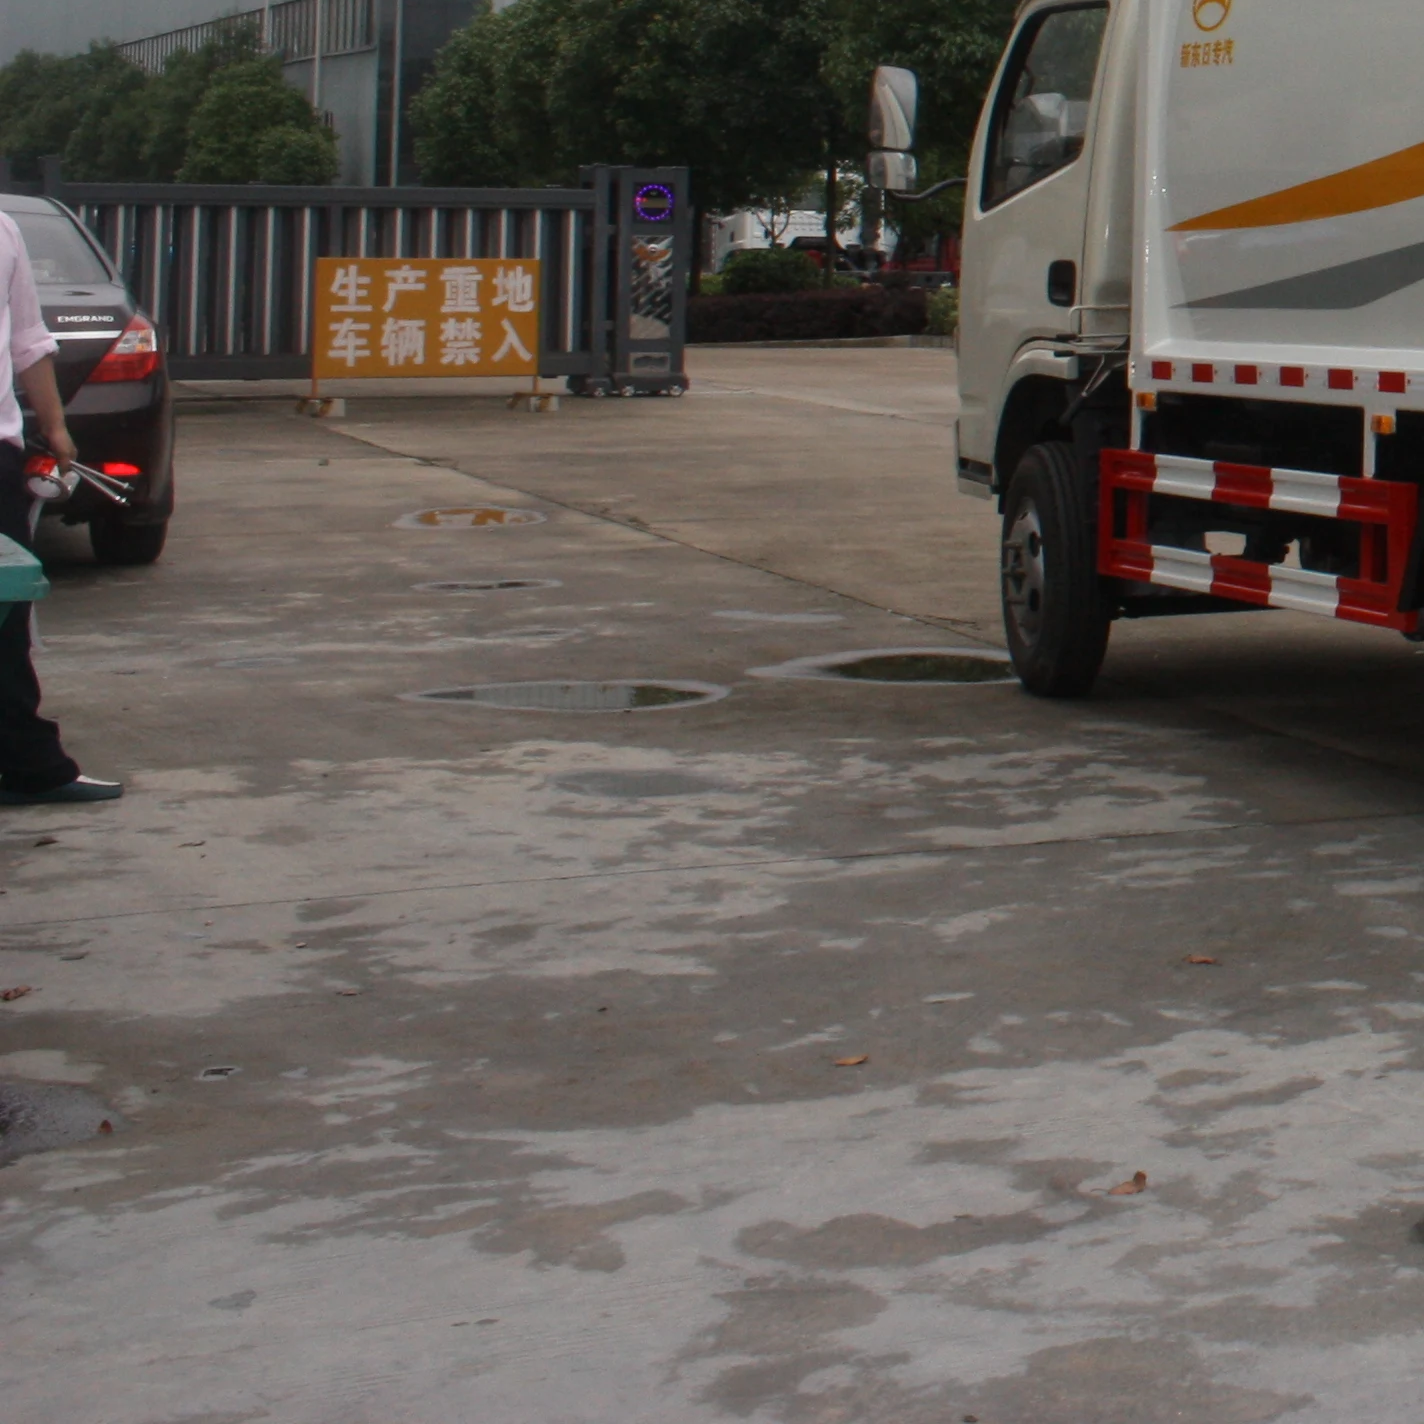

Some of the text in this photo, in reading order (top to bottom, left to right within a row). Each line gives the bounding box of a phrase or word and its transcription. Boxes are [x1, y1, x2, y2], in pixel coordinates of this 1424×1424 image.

[329, 264, 535, 314] 生产重地
[57, 315, 115, 323] EMGRAND
[327, 318, 532, 367] 车辆禁入
